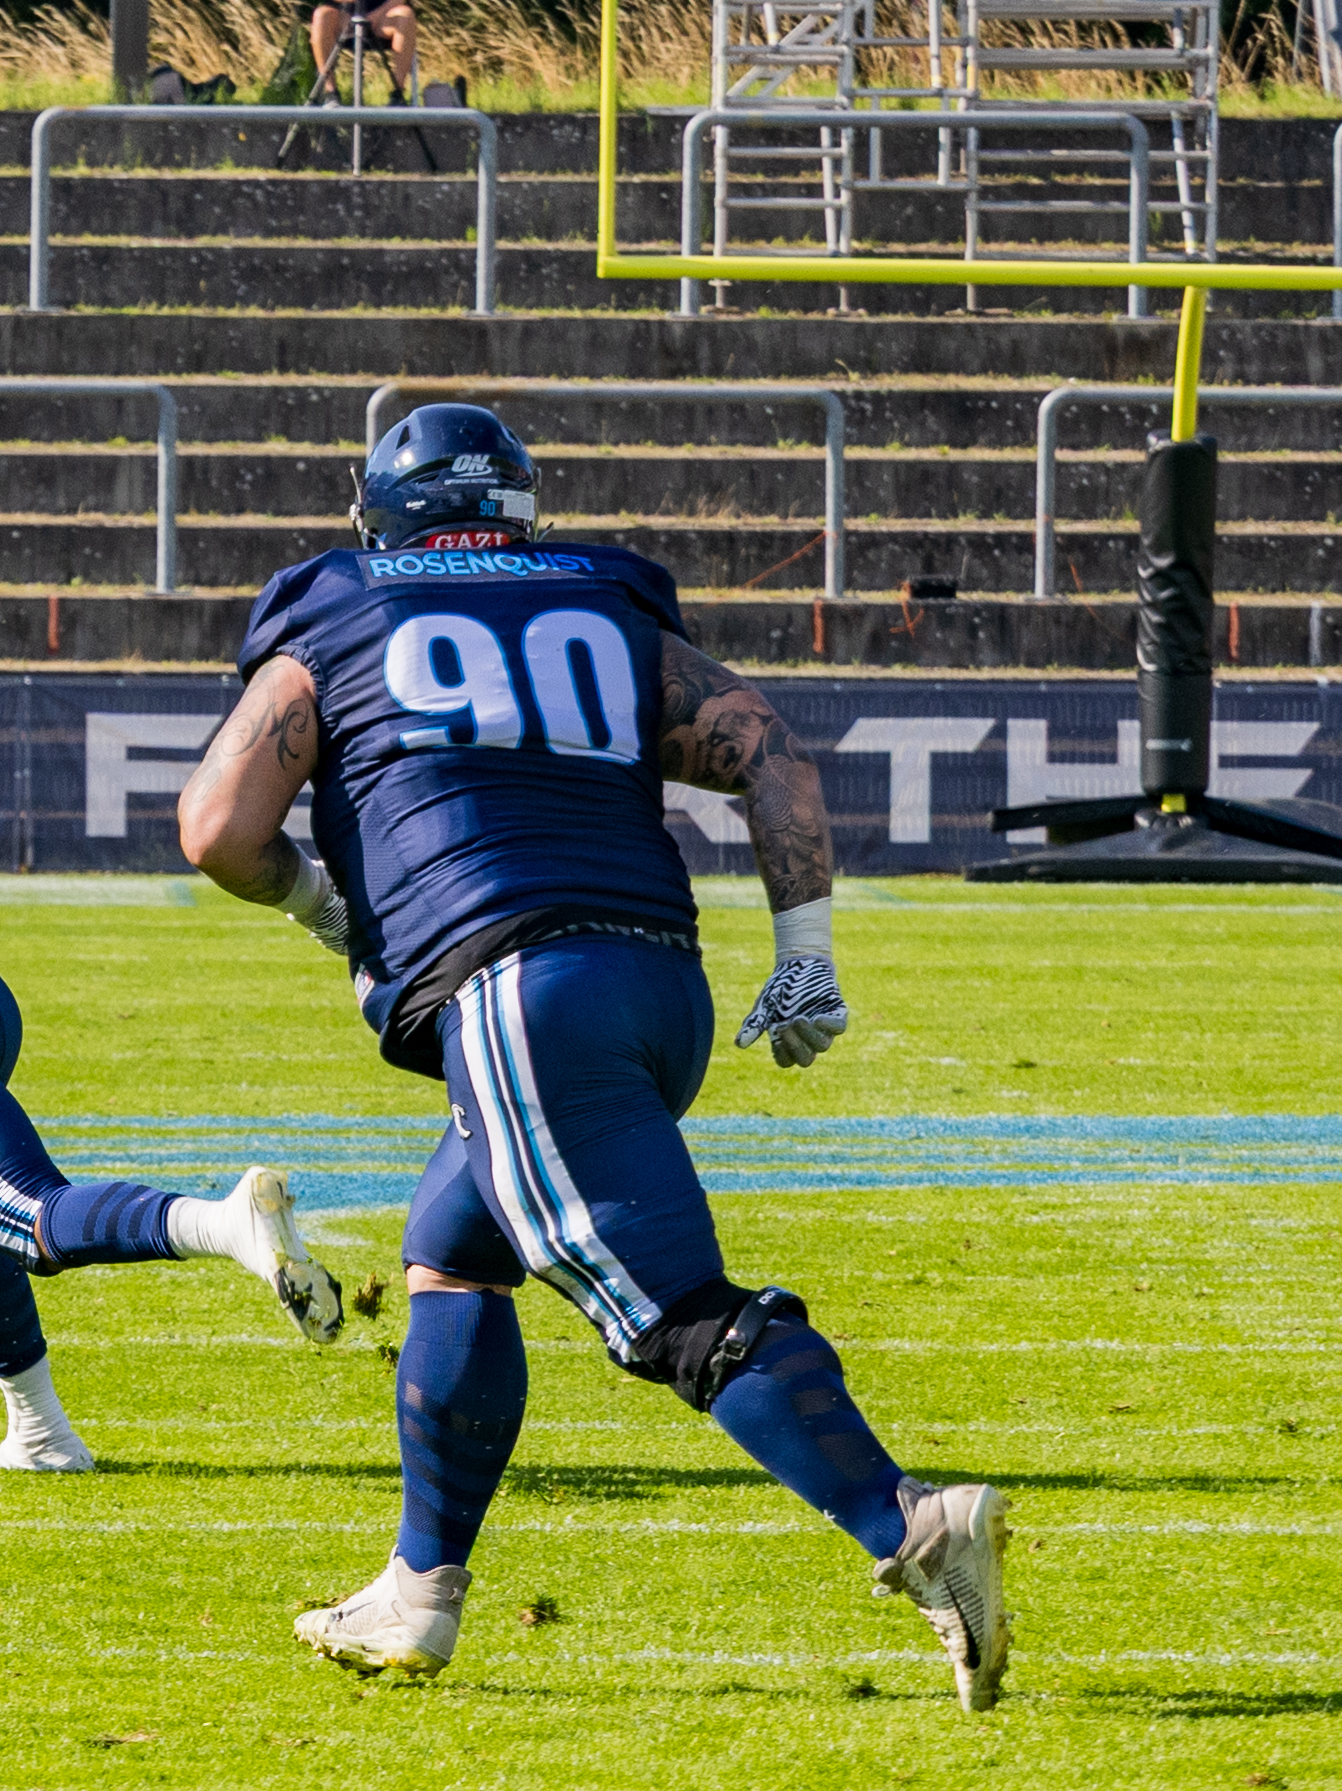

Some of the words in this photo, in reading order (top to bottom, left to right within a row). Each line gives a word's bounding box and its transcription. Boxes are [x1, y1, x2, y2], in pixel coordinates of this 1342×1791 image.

[451, 454, 492, 474] ON
[479, 500, 496, 516] 90
[434, 533, 504, 550] GAZI
[369, 551, 595, 577] ROSENQUIST
[385, 610, 641, 764] 90
